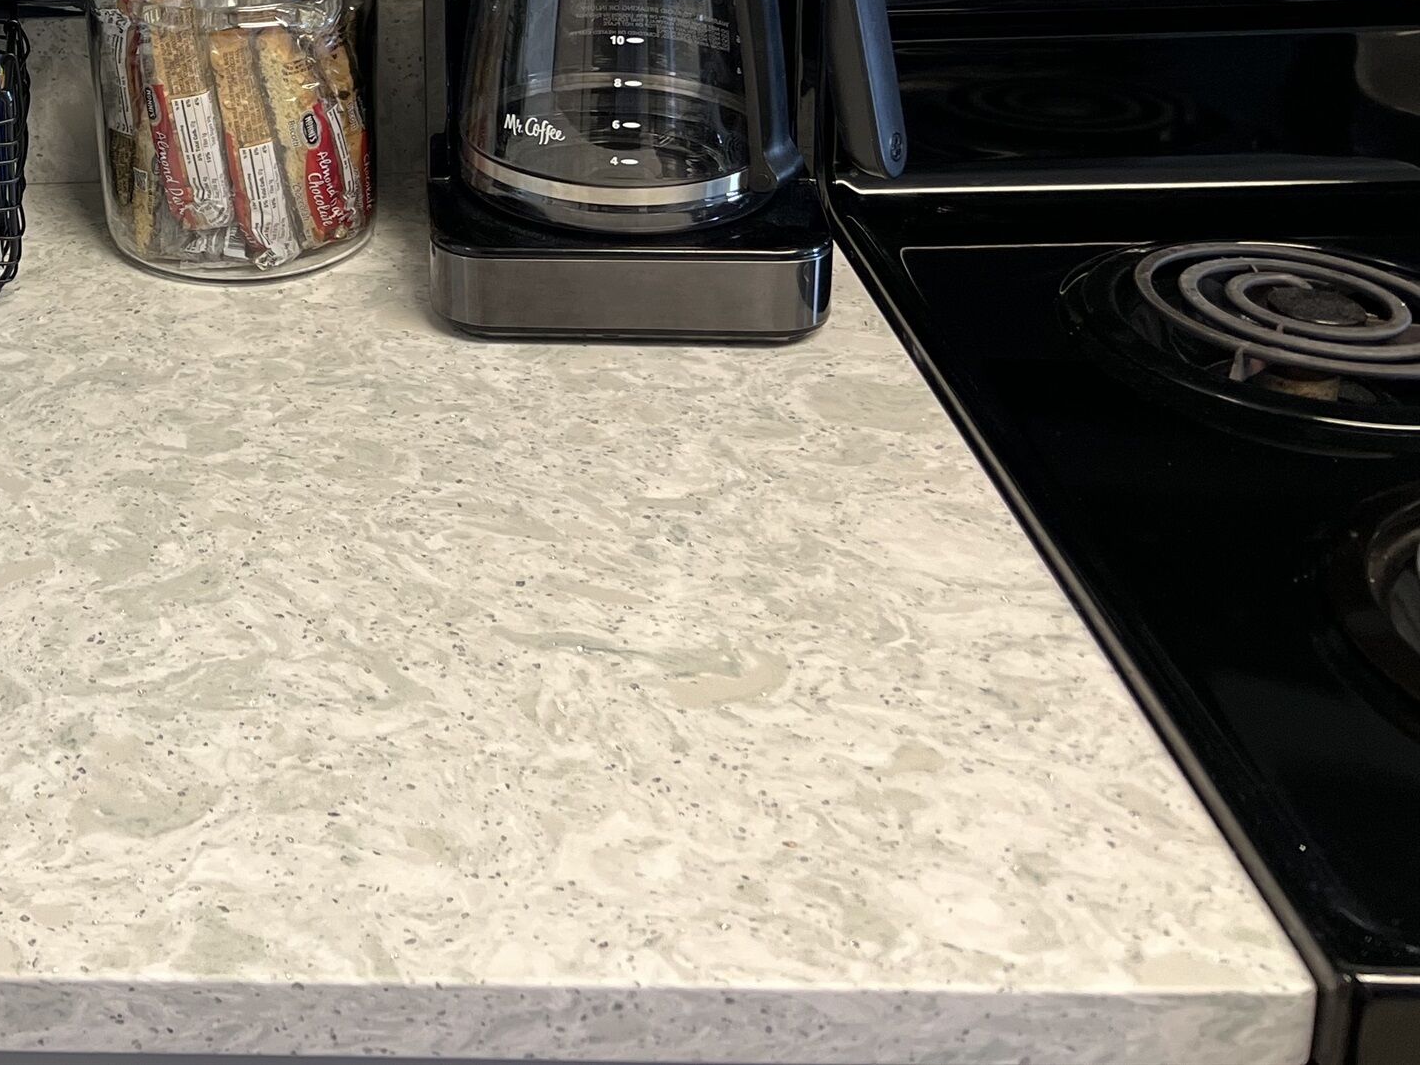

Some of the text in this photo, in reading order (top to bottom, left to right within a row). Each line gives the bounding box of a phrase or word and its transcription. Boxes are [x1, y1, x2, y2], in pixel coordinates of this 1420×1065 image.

[610, 35, 625, 46] 10
[613, 78, 622, 88] 8
[503, 113, 566, 146] Mr. Coffee
[611, 120, 621, 130] 6
[156, 131, 180, 184] Almond
[610, 156, 619, 166] 4
[317, 151, 340, 198] Almond
[307, 172, 333, 227] Chocolate
